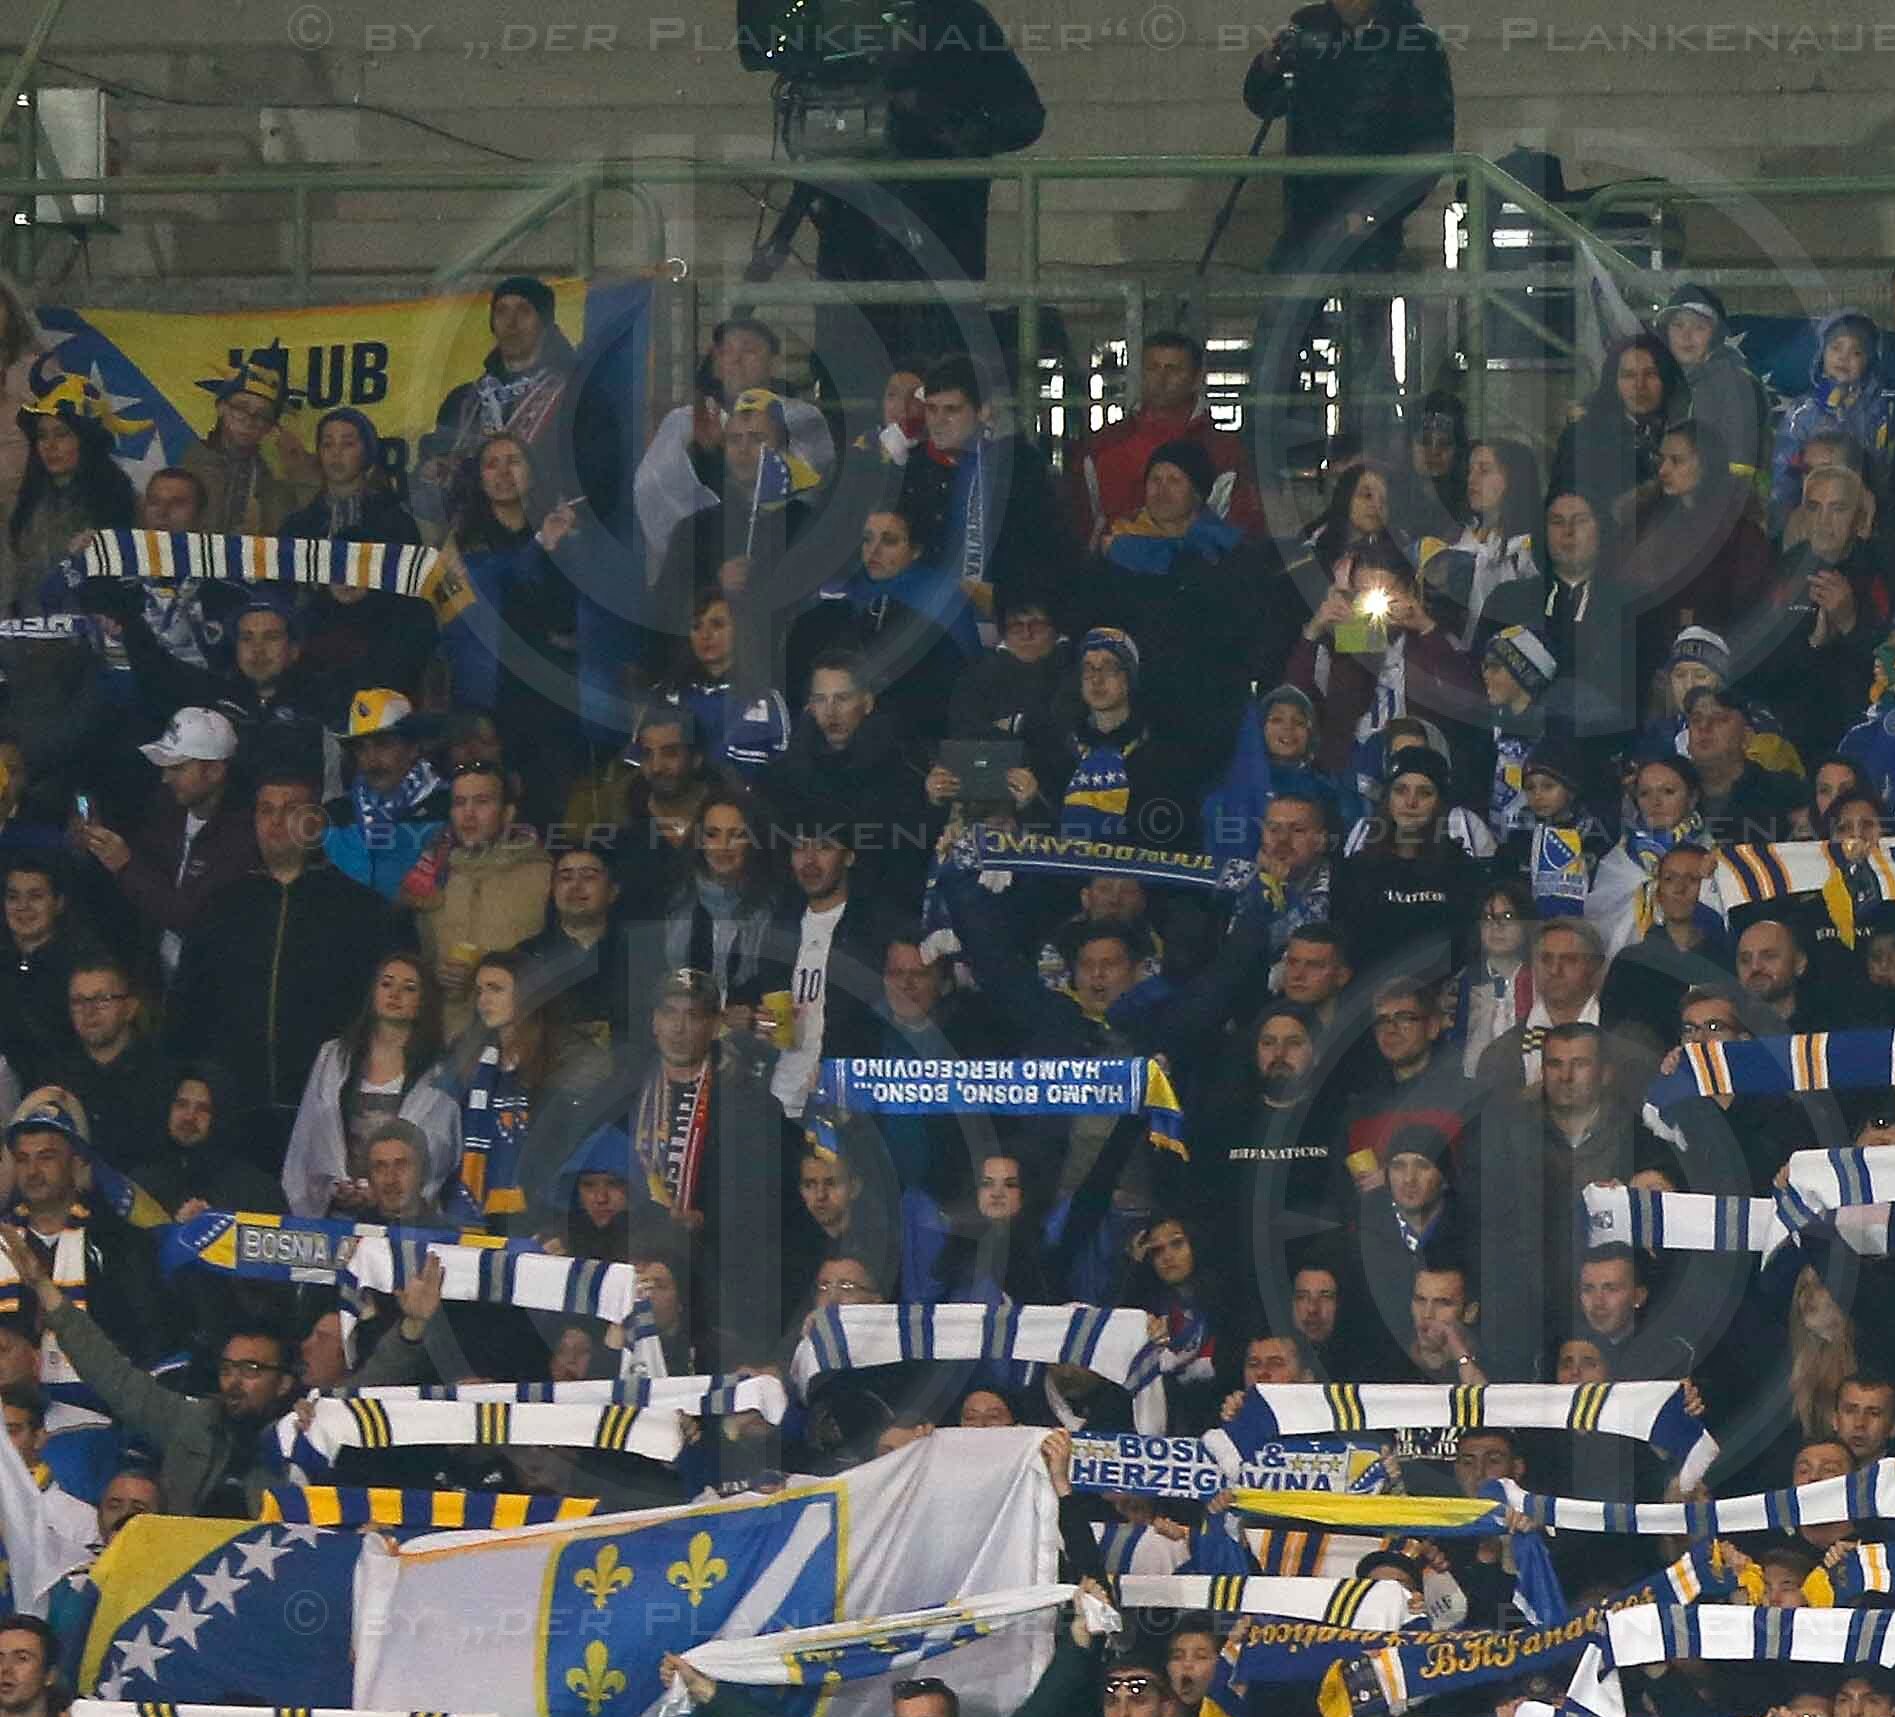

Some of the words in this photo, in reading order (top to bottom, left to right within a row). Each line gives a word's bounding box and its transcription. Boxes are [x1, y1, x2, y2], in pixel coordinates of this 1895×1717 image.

[850, 1058, 1014, 1080] HERCEGOVINO
[1044, 1083, 1125, 1104] HAJMO
[1263, 1442, 1287, 1467] &
[1071, 1460, 1333, 1491] HERZEGVINA
